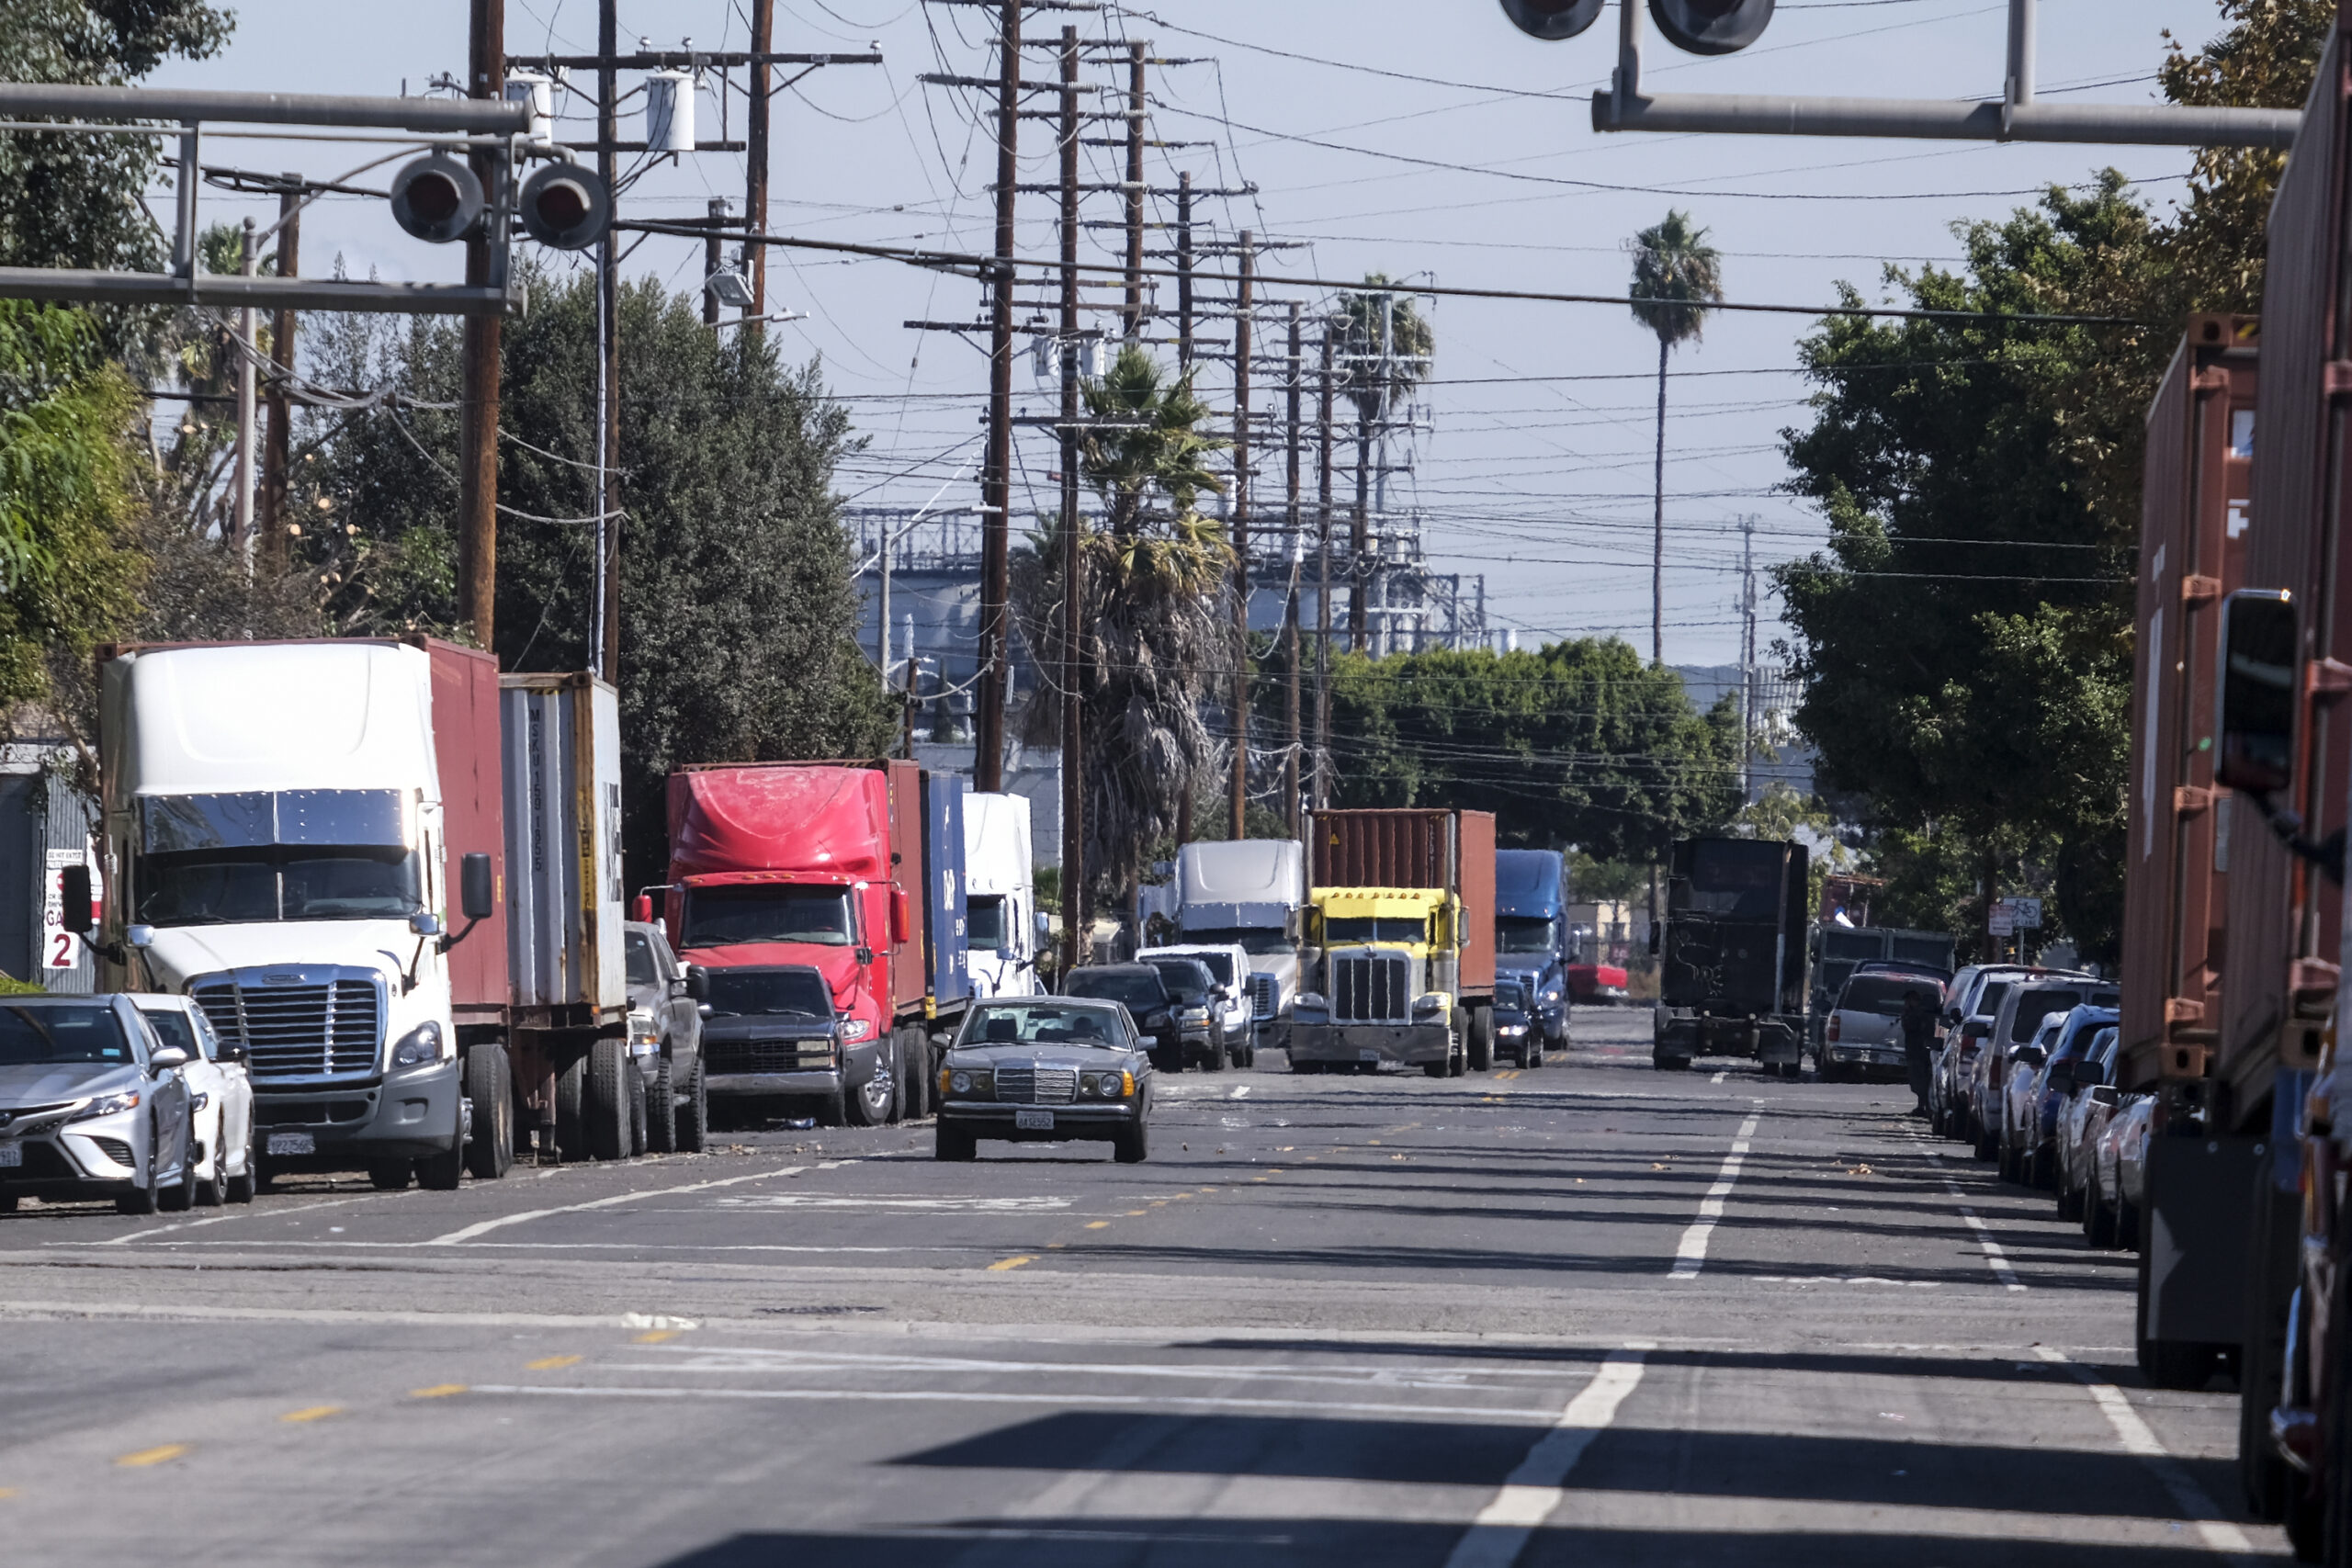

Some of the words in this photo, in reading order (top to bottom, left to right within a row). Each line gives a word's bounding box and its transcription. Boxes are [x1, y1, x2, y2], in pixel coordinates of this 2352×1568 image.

[530, 709, 540, 766] MSKU
[47, 910, 64, 926] GA
[52, 933, 71, 966] 2
